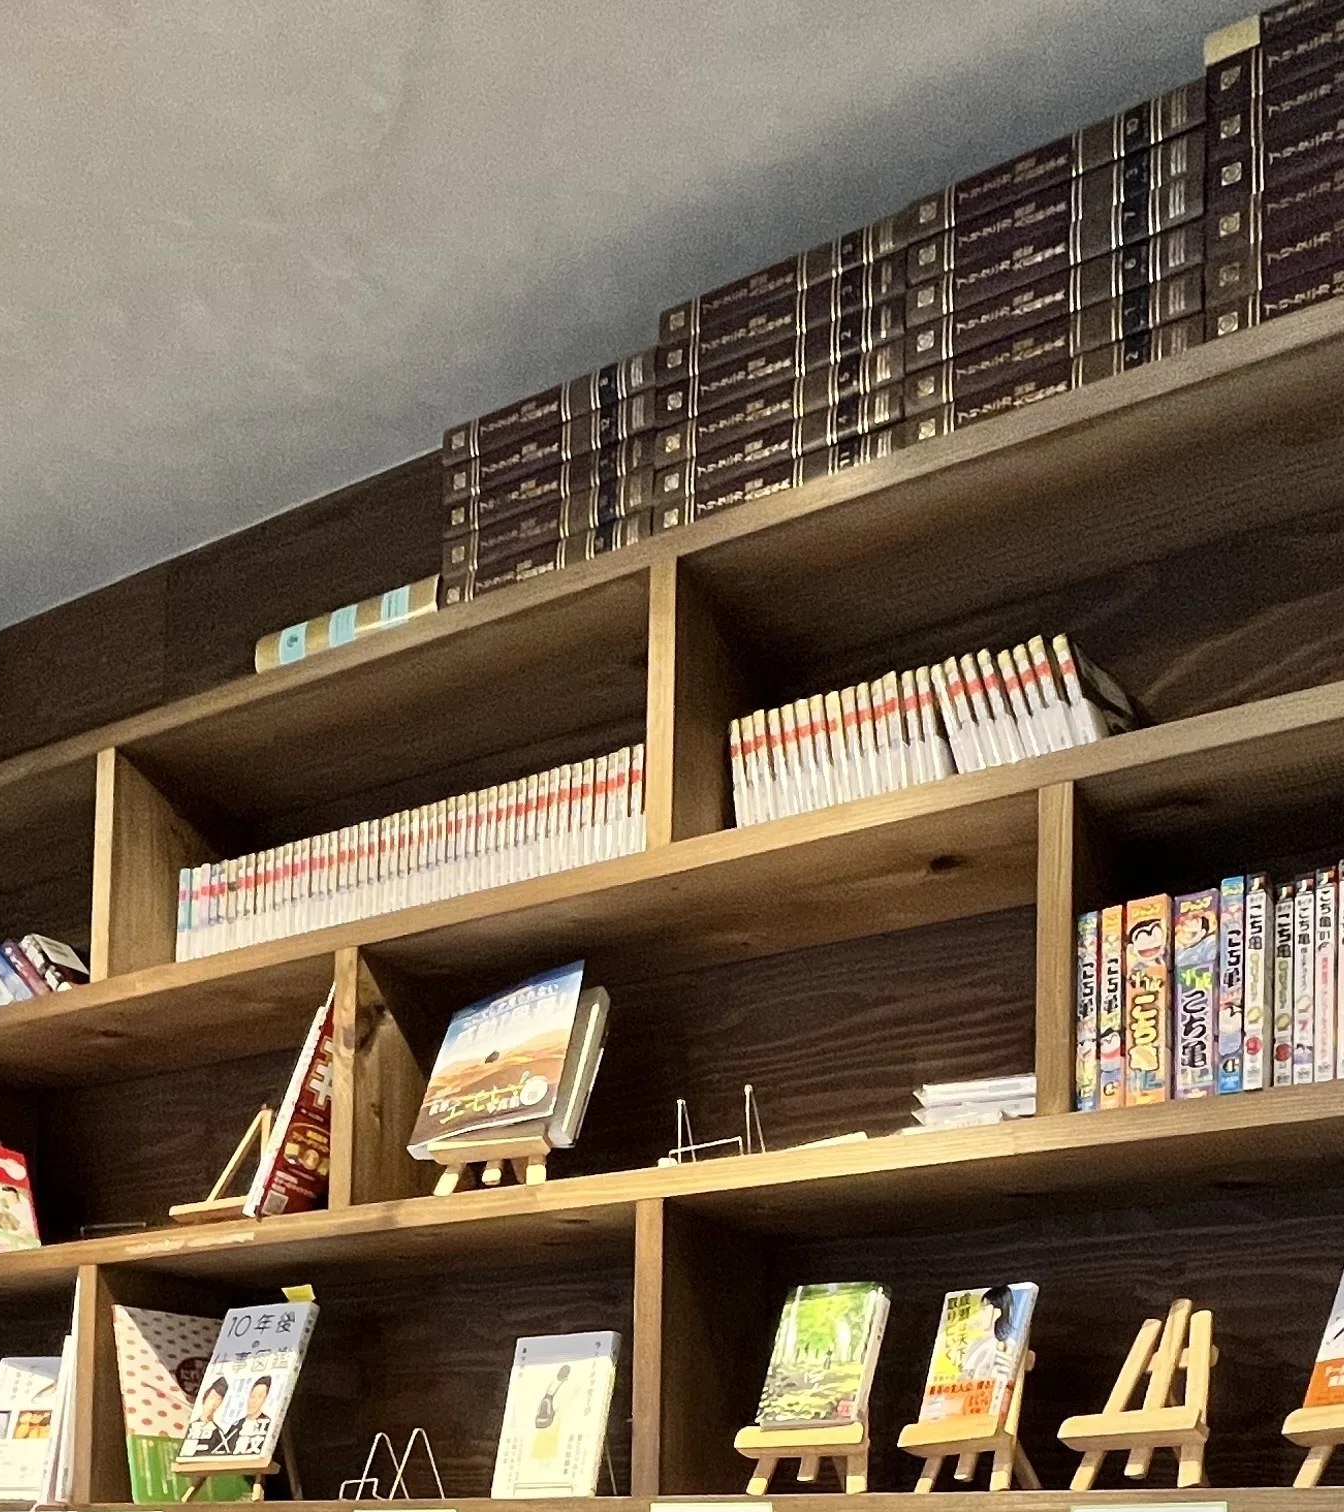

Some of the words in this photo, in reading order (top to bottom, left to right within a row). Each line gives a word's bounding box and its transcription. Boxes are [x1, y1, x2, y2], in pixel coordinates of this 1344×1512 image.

[1181, 989, 1207, 1068] こち亀
[227, 1310, 296, 1338] 10年後
